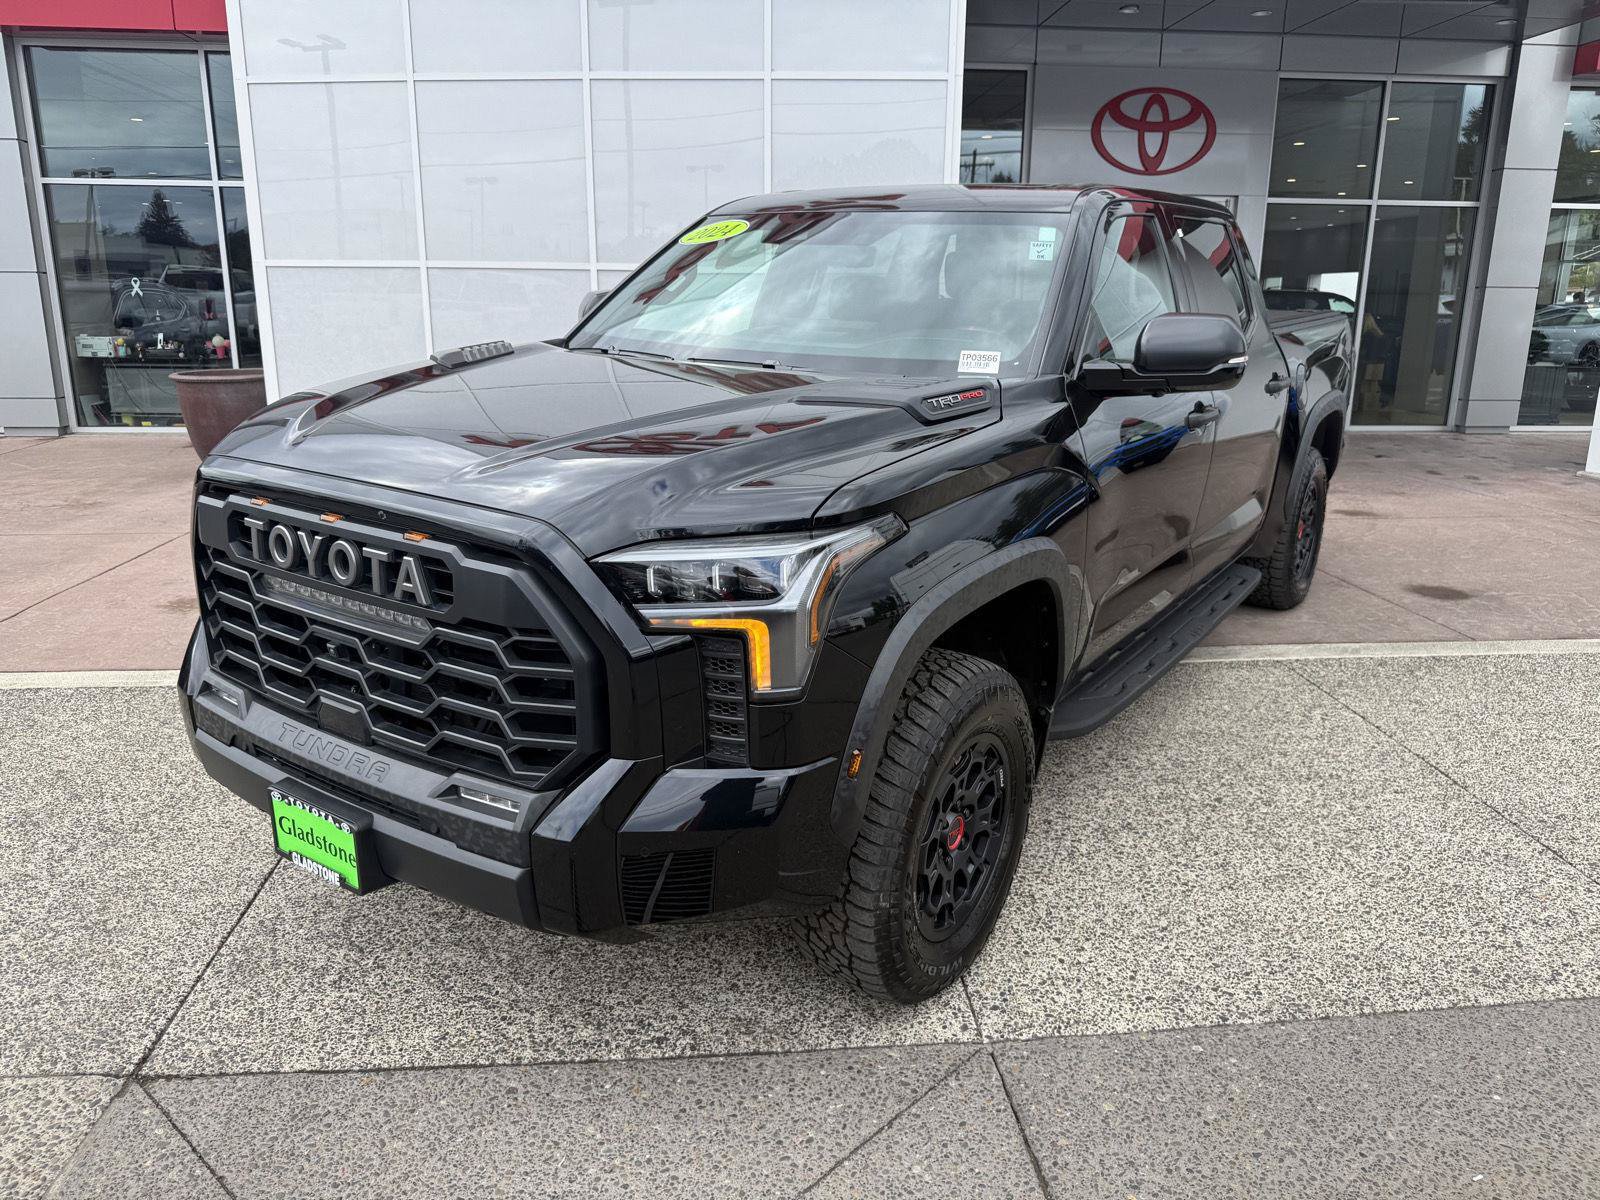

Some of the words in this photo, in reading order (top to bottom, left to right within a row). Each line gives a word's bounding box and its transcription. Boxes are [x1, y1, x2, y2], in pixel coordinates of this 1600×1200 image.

[686, 223, 742, 241] 2024
[244, 516, 434, 606] TOYOTA
[277, 721, 391, 784] TUNDRA
[287, 796, 336, 825] TOYOTA
[278, 815, 357, 868] Gladstone
[291, 851, 341, 886] GLADSTONE
